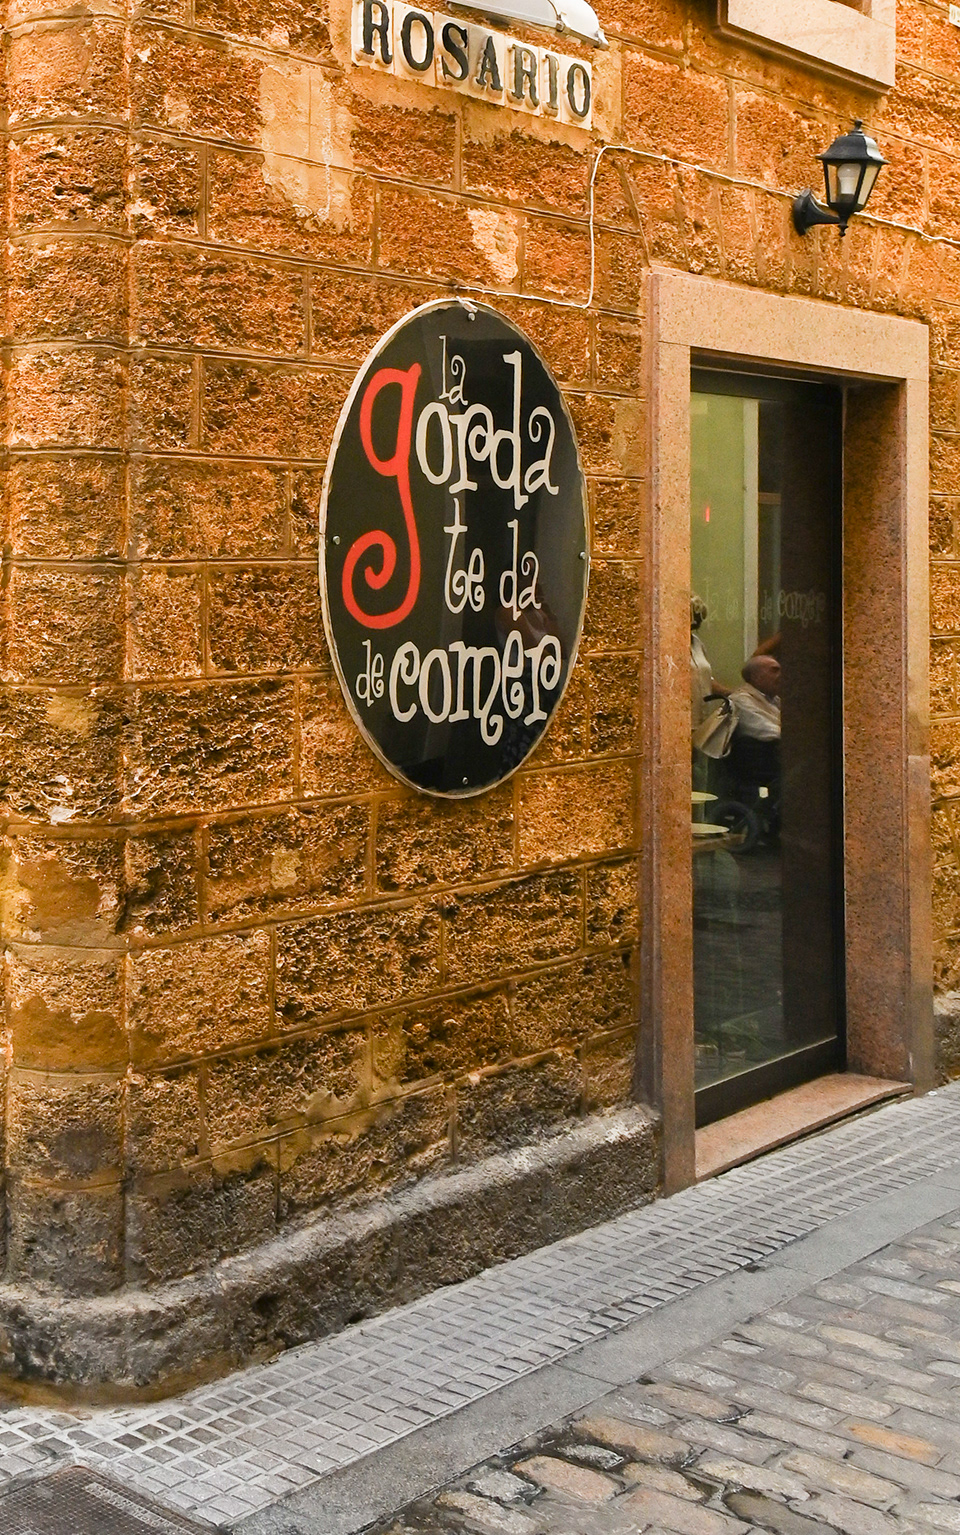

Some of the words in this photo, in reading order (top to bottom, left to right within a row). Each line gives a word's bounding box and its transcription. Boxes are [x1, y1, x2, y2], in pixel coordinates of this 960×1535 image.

[438, 335, 469, 406] la
[342, 350, 560, 630] gorda
[443, 498, 485, 614] te
[499, 519, 542, 621] da
[356, 639, 385, 708] de
[388, 629, 562, 747] comer
